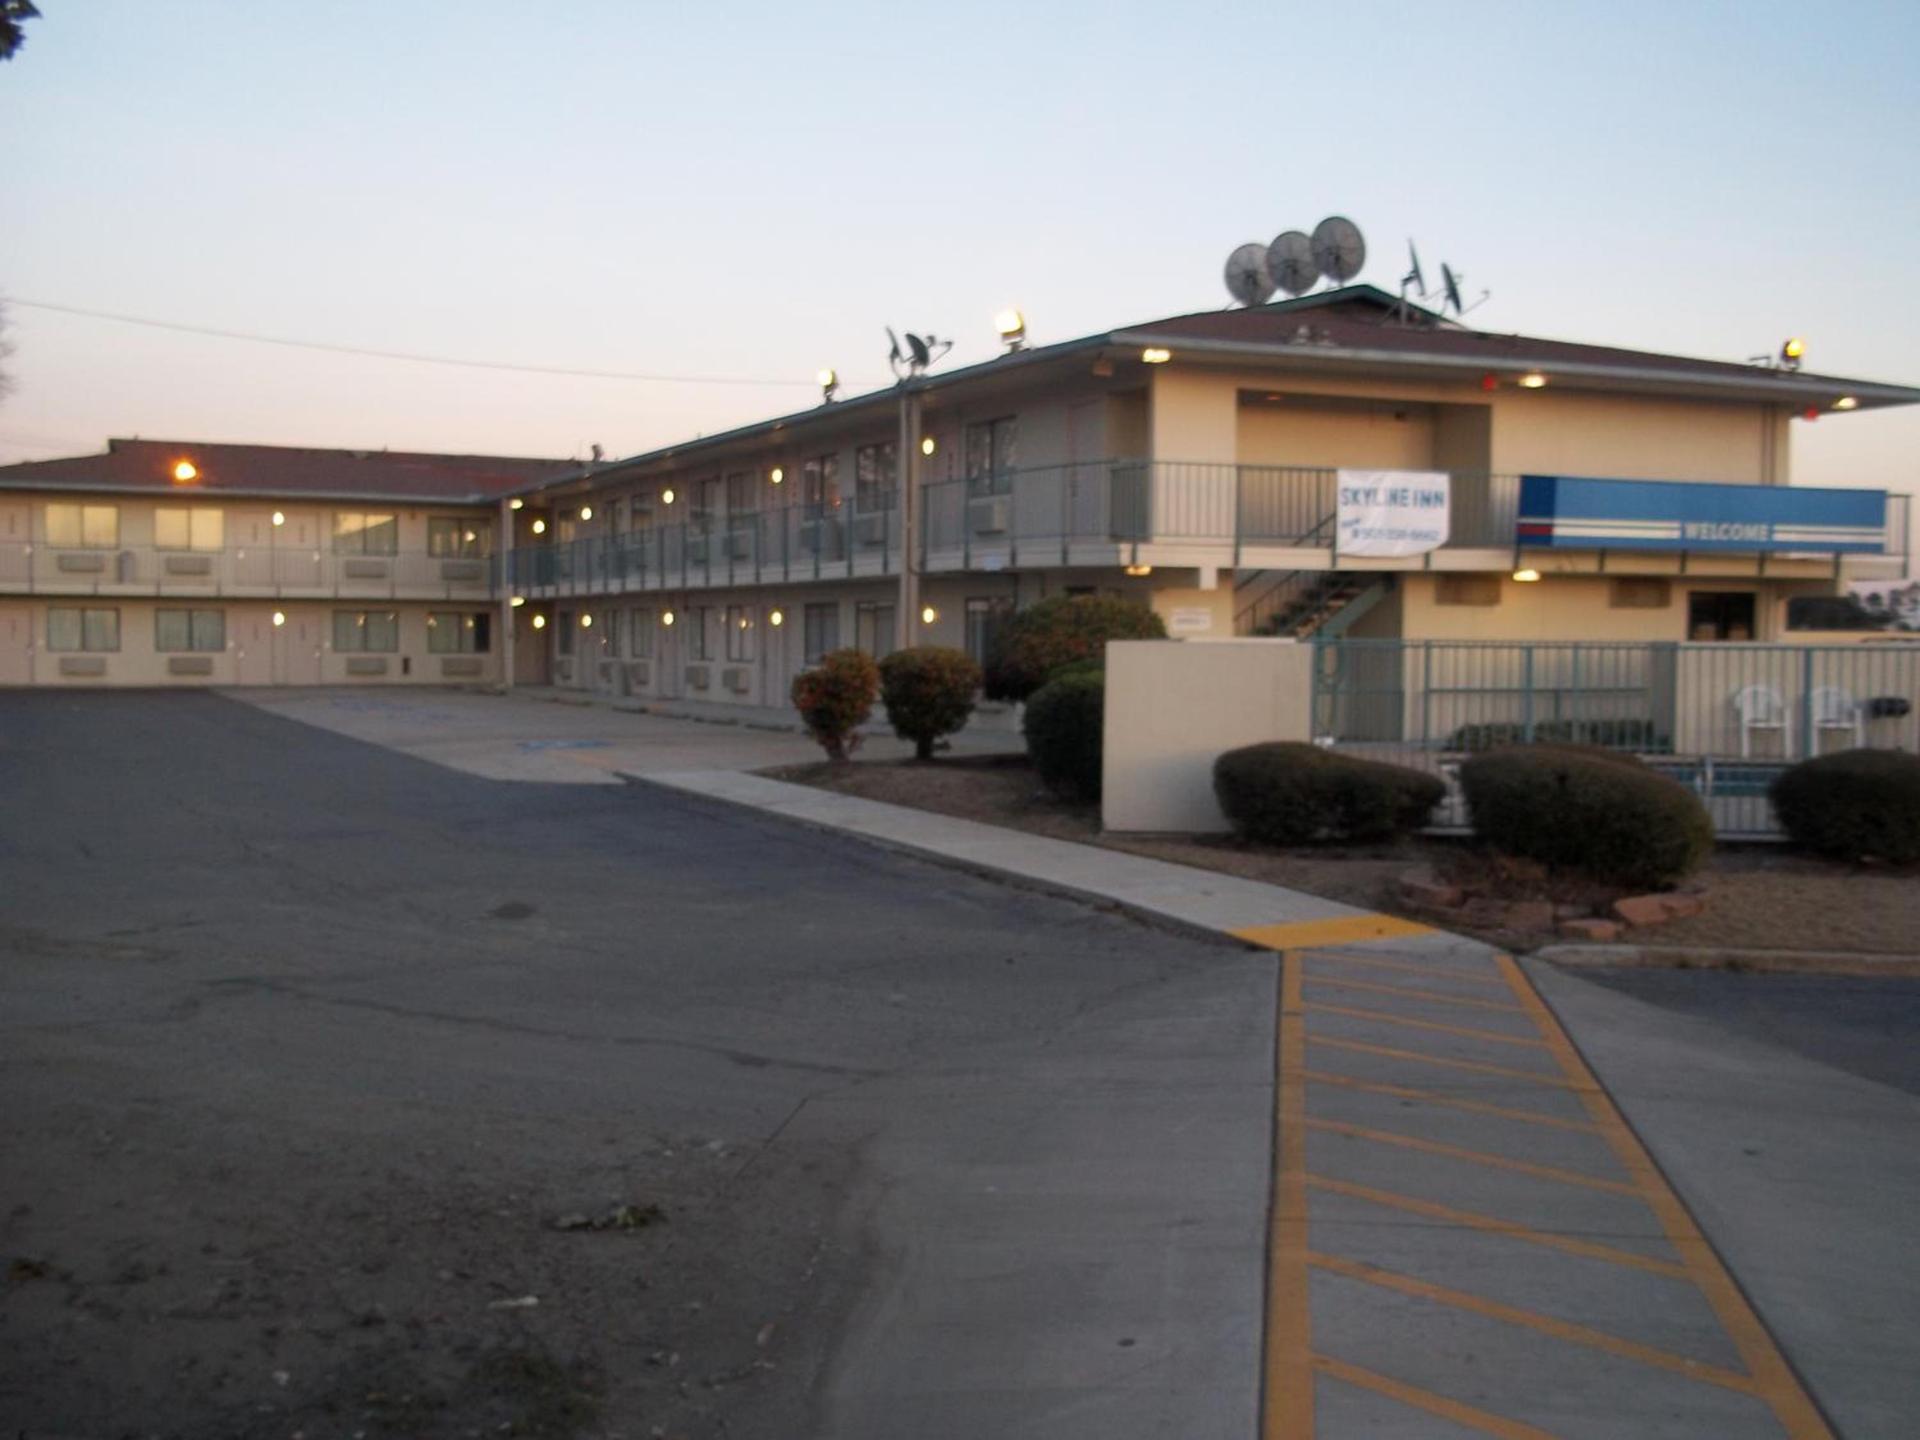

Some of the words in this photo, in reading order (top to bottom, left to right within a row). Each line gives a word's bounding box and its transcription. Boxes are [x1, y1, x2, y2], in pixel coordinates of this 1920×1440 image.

[1340, 487, 1410, 507] SKYLNE
[1413, 489, 1445, 509] INN
[1684, 521, 1769, 542] WELCOME
